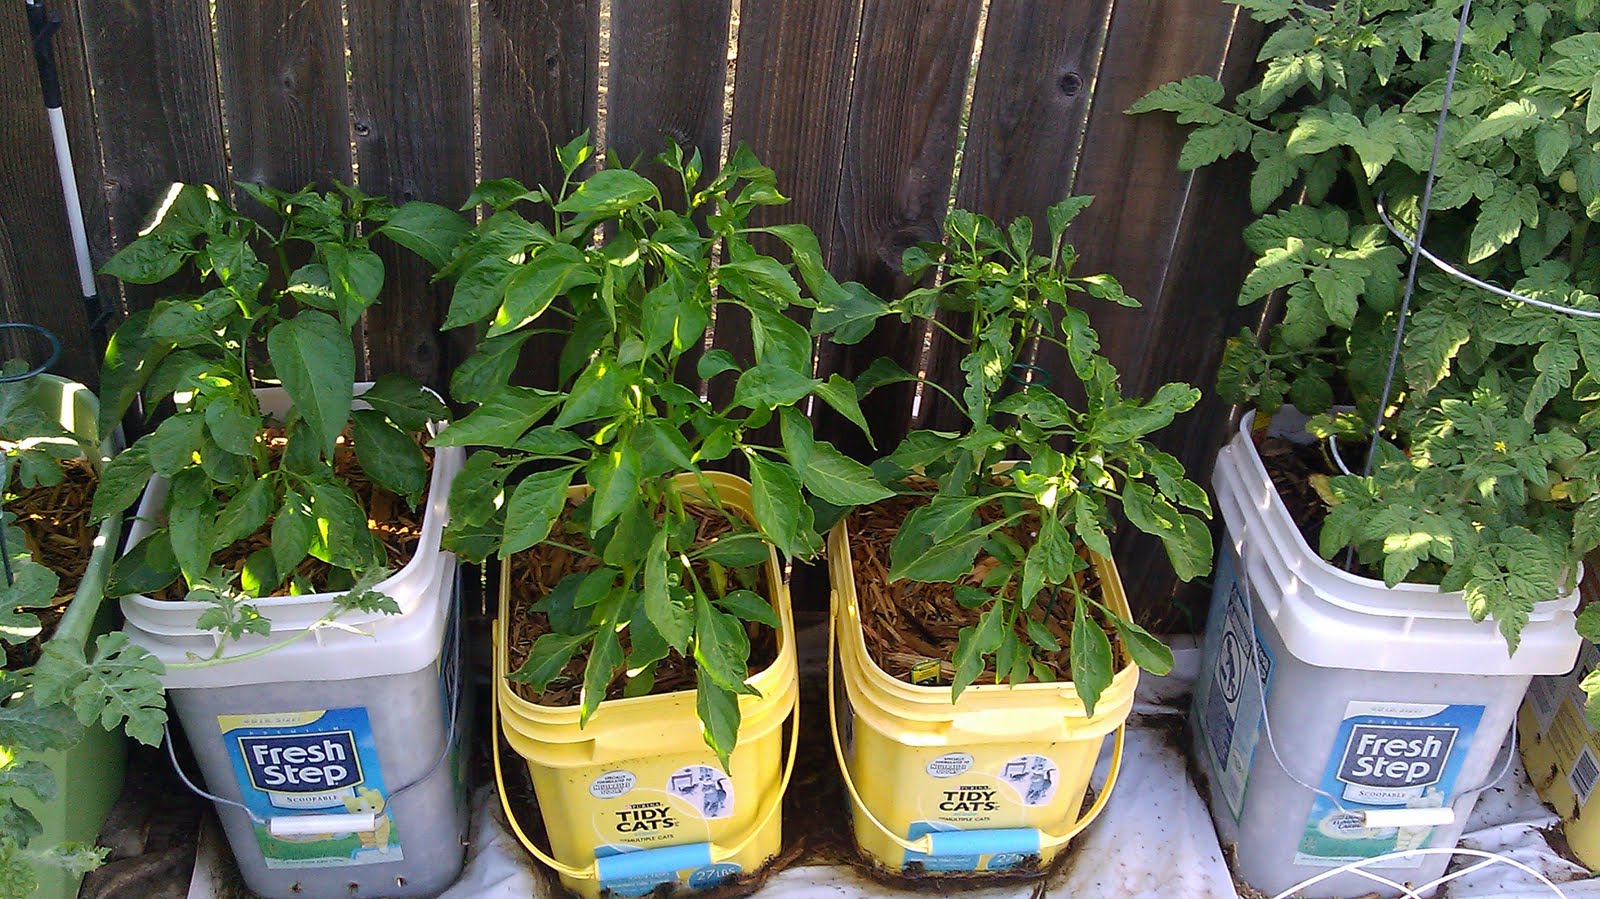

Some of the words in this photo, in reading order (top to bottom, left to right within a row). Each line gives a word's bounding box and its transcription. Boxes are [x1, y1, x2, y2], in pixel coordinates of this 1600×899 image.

[252, 740, 346, 765] Fresh
[1356, 734, 1442, 758] Fresh
[263, 765, 348, 786] Step
[1352, 756, 1430, 783] Step
[943, 790, 997, 801] TIDY
[631, 801, 661, 810] PURINA
[939, 801, 995, 812] CATS
[615, 806, 671, 822] TIDY
[616, 818, 674, 832] CATS
